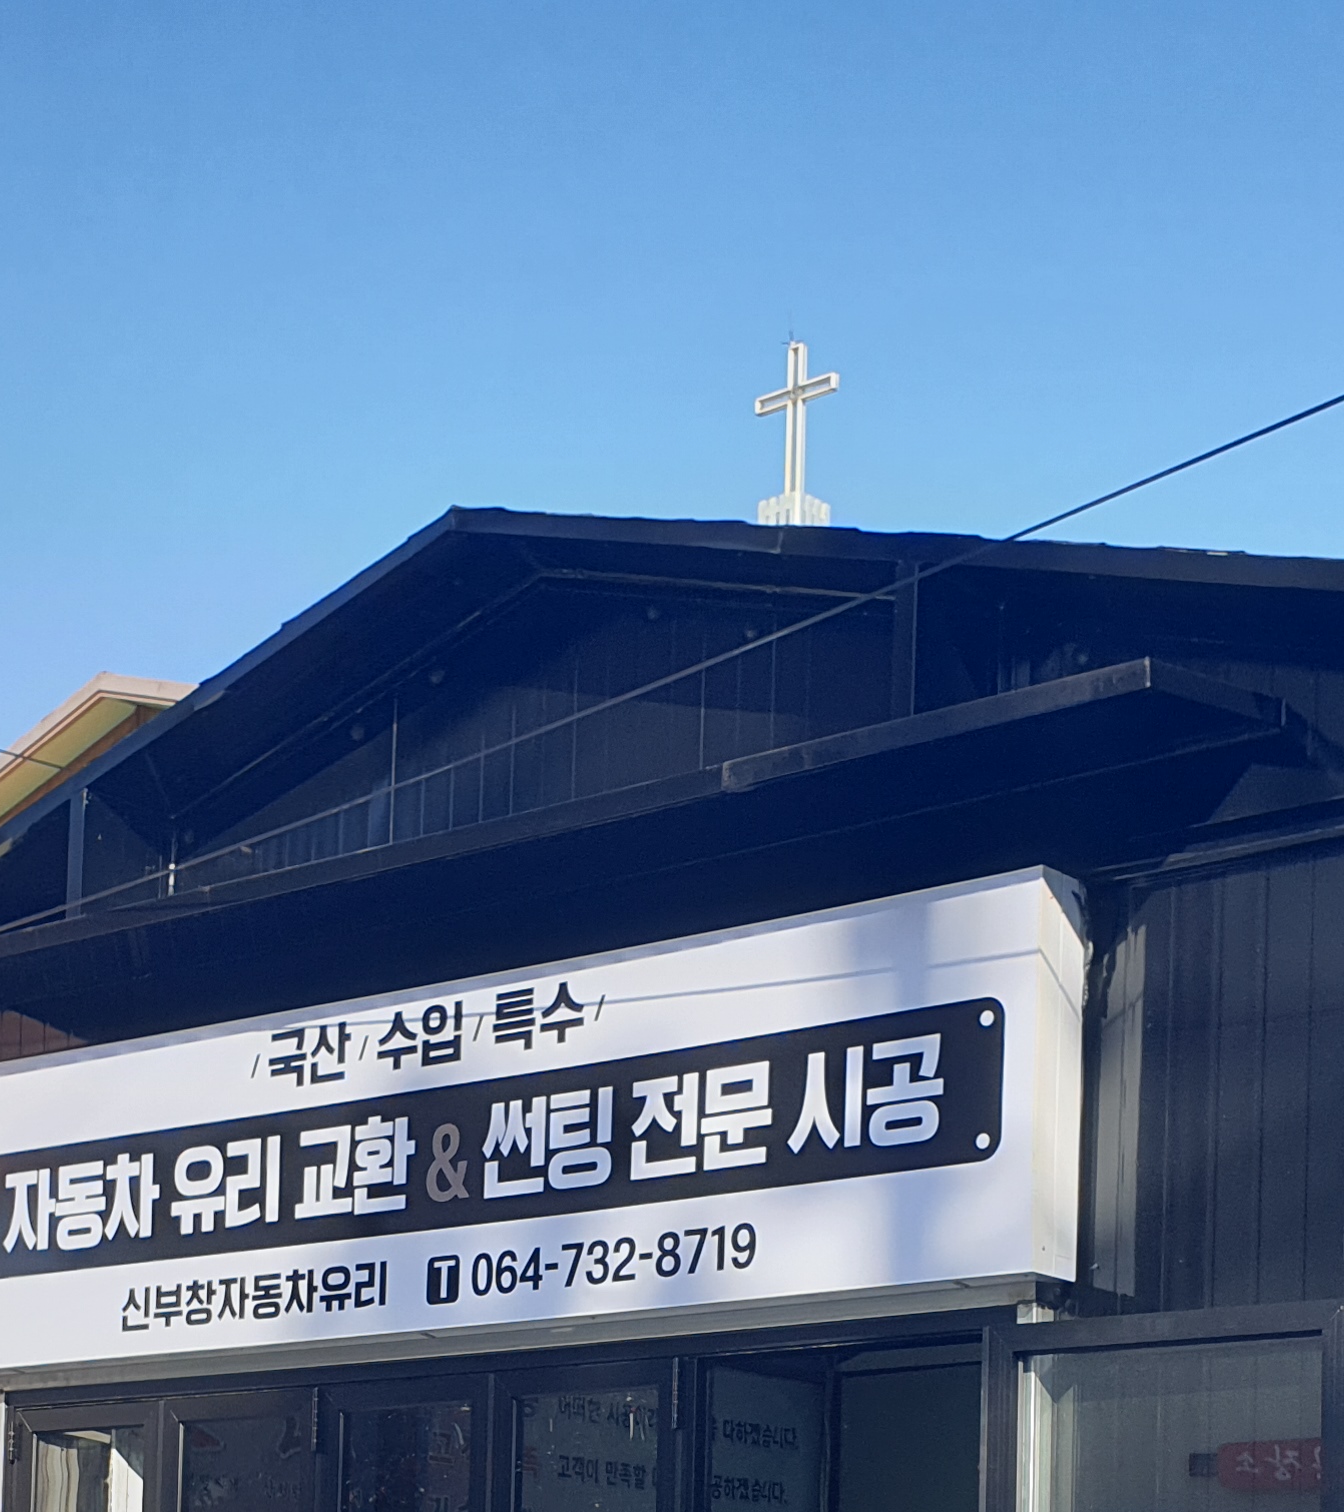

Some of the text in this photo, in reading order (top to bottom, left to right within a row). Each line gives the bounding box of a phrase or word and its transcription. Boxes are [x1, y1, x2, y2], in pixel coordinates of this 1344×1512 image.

[3, 1033, 945, 1254] 자동차 유리 교환 & 썬팅 전문 시공
[121, 1261, 387, 1332] 신부창자동차유리
[470, 1222, 756, 1296] 064-732-8719
[557, 1454, 599, 1484] 고객이
[605, 1460, 645, 1490] 만족할
